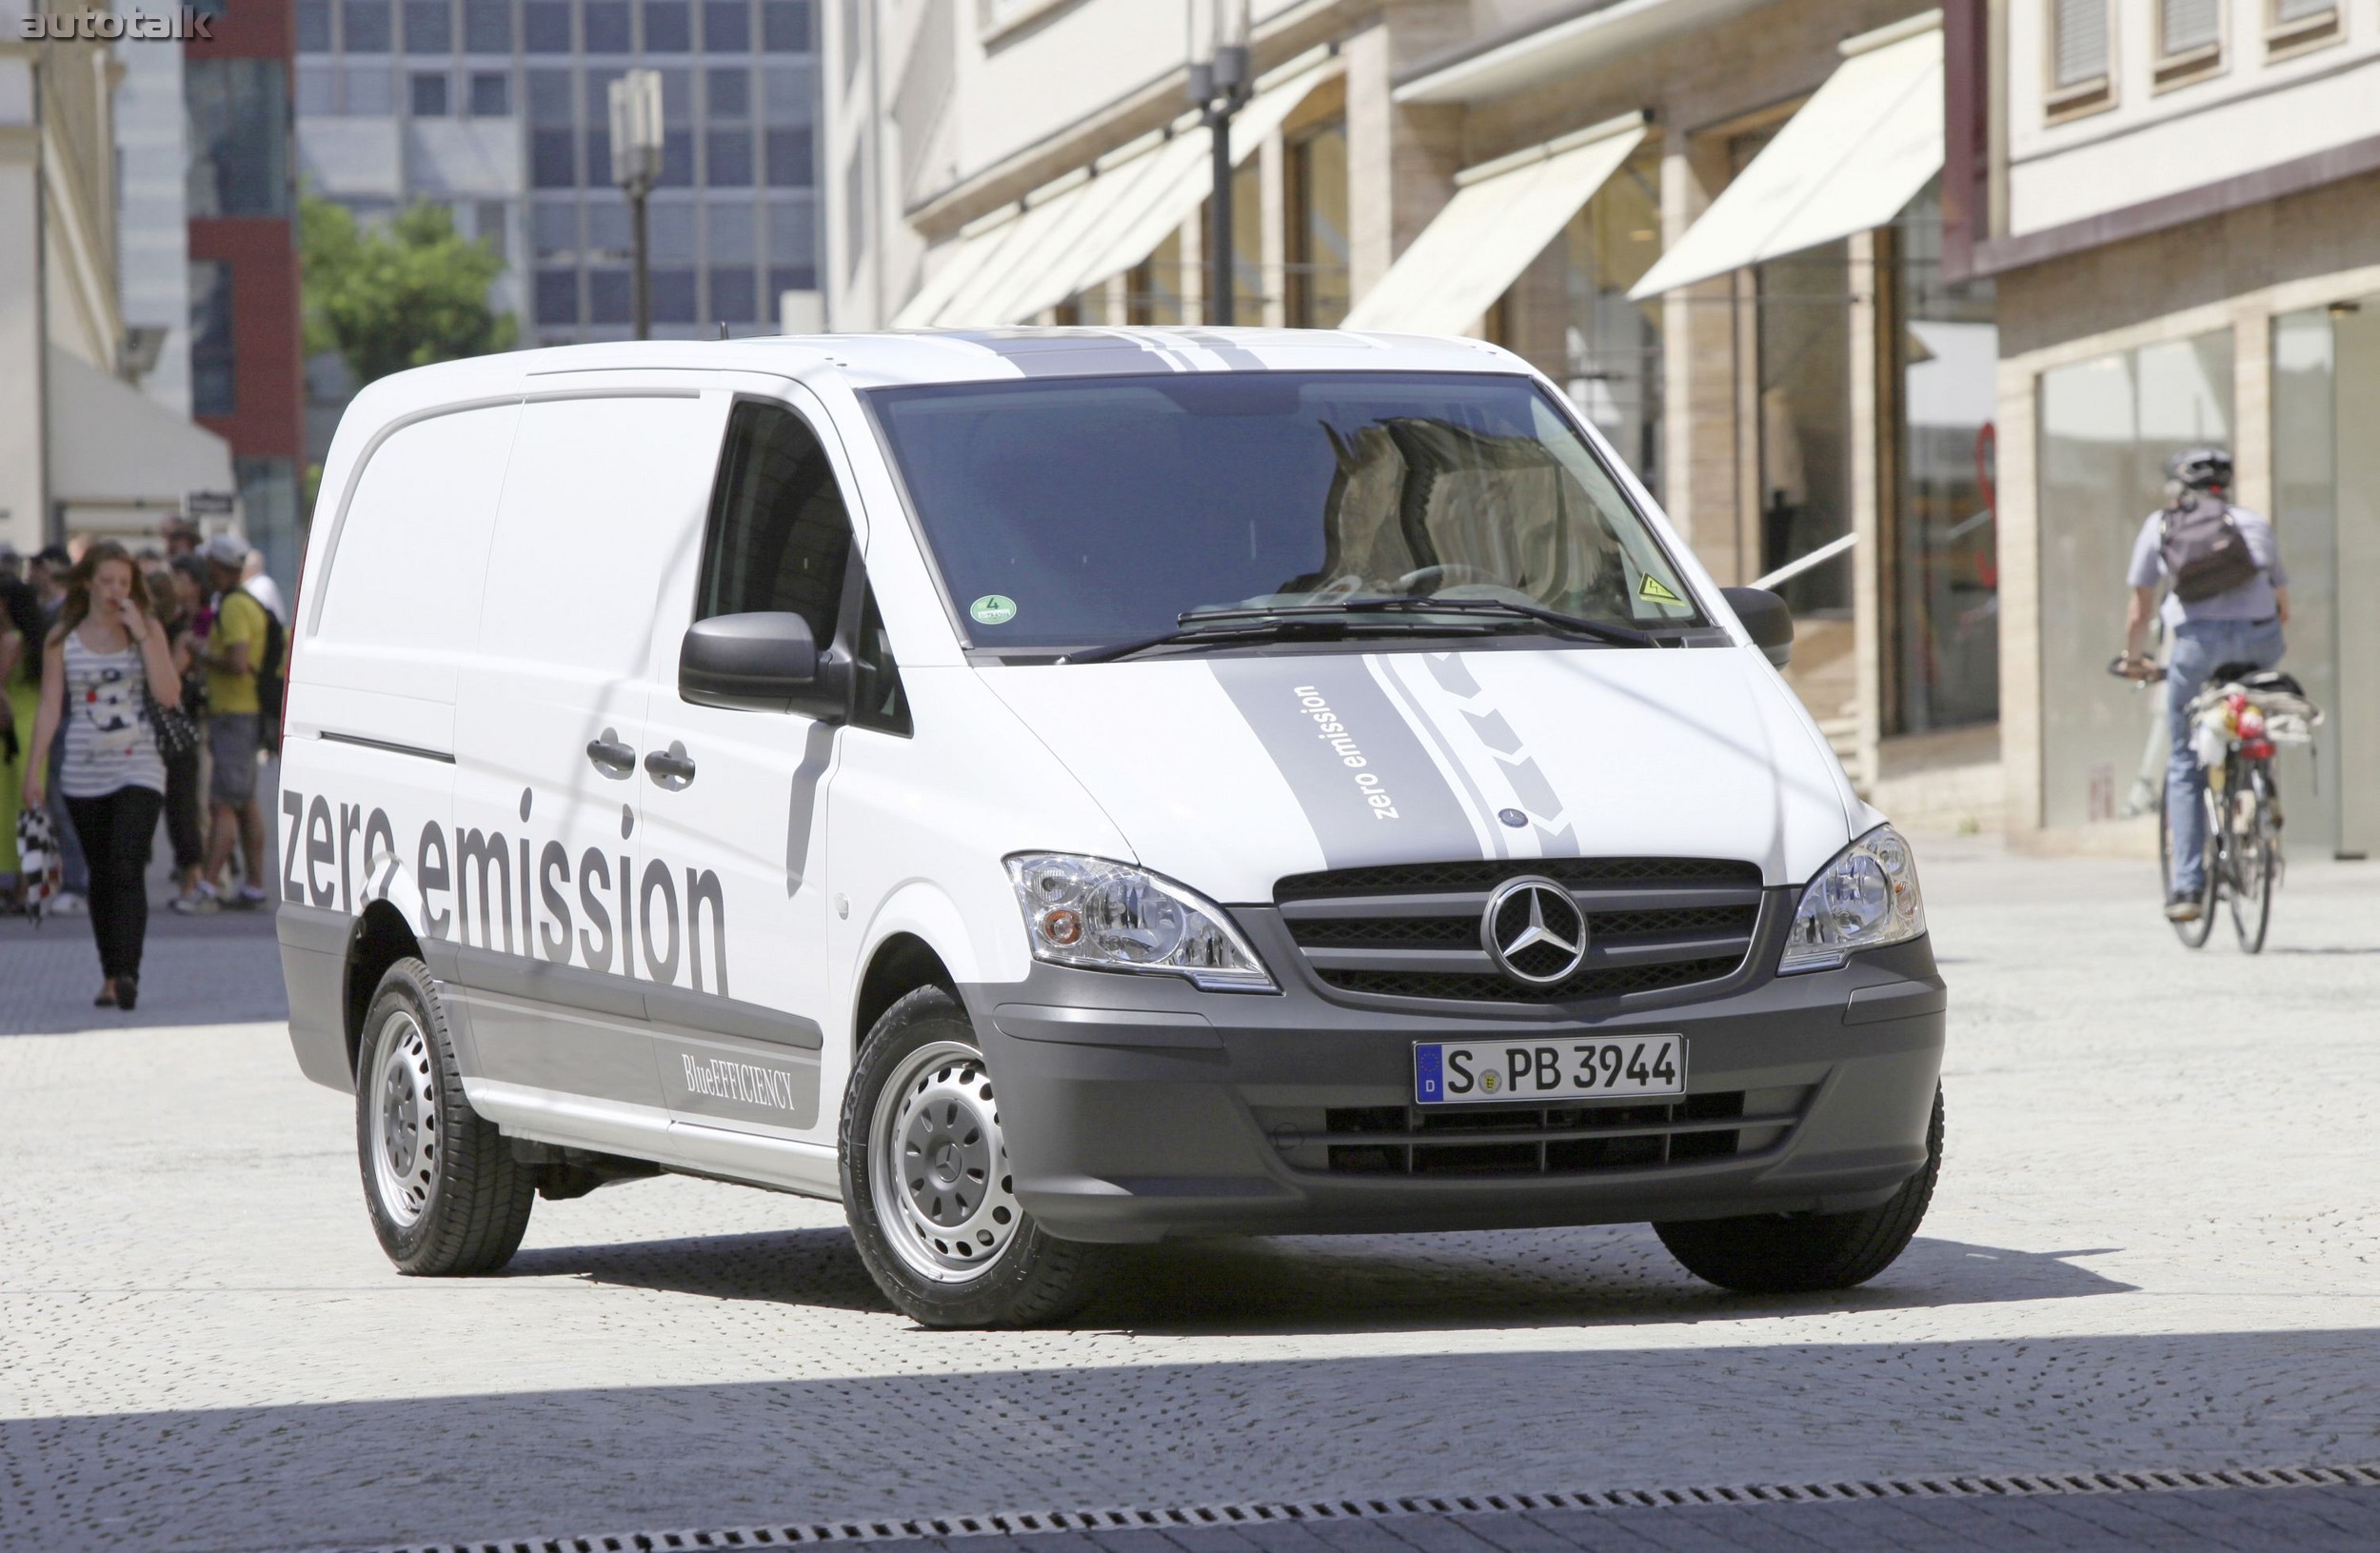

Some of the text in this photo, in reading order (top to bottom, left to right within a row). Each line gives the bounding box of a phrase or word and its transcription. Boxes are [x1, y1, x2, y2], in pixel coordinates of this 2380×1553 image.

[986, 597, 1000, 609] 4
[1294, 686, 1399, 820] zero emission
[283, 786, 729, 998] zero emission
[682, 1053, 796, 1111] BlueEFFICIENCY
[1425, 1080, 1436, 1092] D
[1448, 1042, 1676, 1094] S PB 3944
